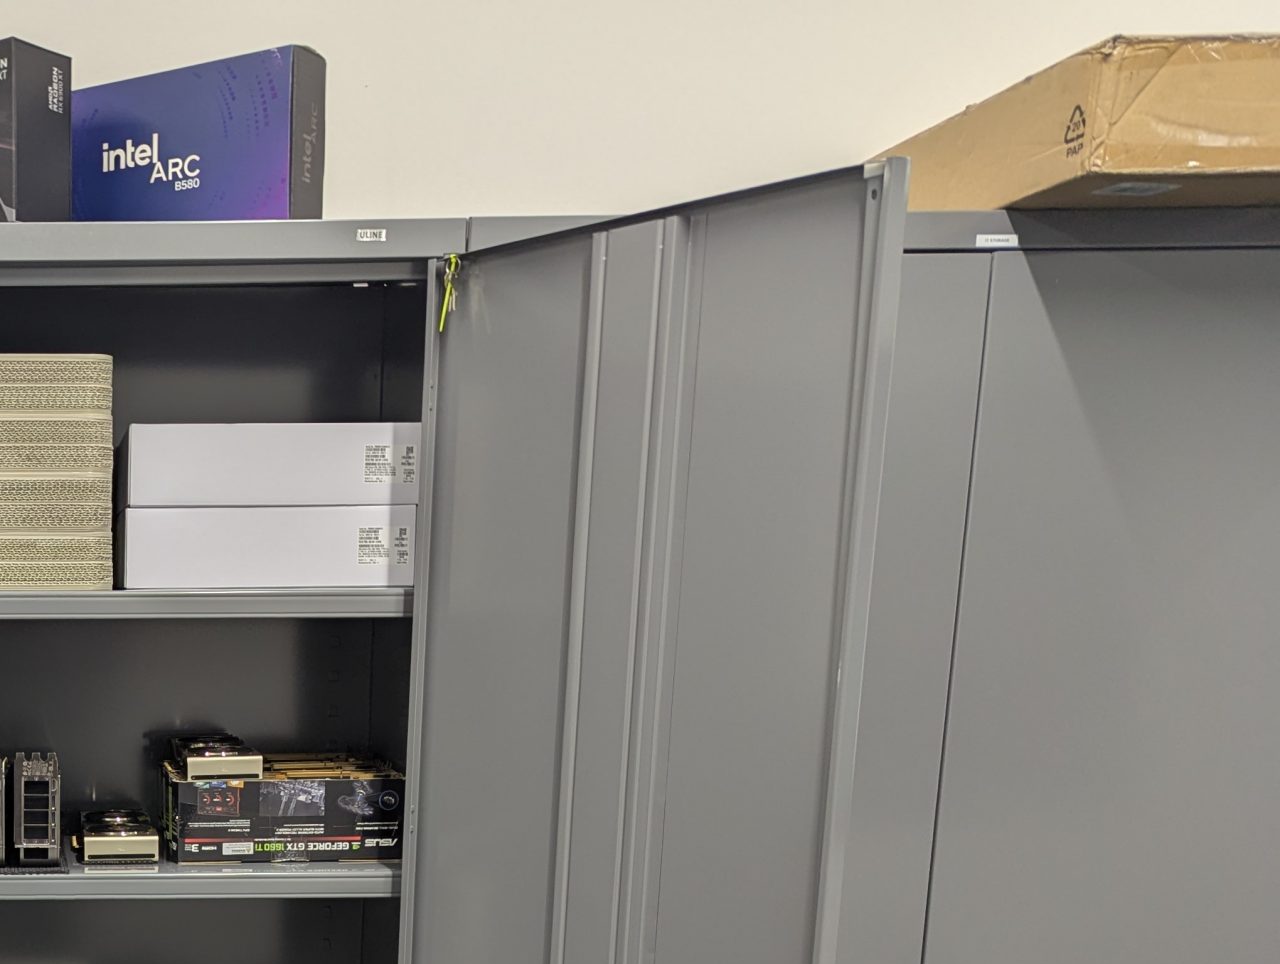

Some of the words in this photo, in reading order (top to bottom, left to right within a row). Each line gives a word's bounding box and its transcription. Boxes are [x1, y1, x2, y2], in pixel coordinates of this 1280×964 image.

[51, 66, 59, 112] RADEON
[1071, 120, 1081, 132] 20
[103, 133, 159, 173] intel
[1066, 143, 1084, 158] PAP
[302, 132, 313, 184] intel
[149, 155, 201, 183] ARC
[175, 178, 201, 191] B580
[359, 230, 383, 240] ULINE
[264, 842, 285, 850] 1660
[285, 842, 306, 851] GTX
[308, 841, 349, 850] GEFORCE
[364, 838, 399, 847] ASUS
